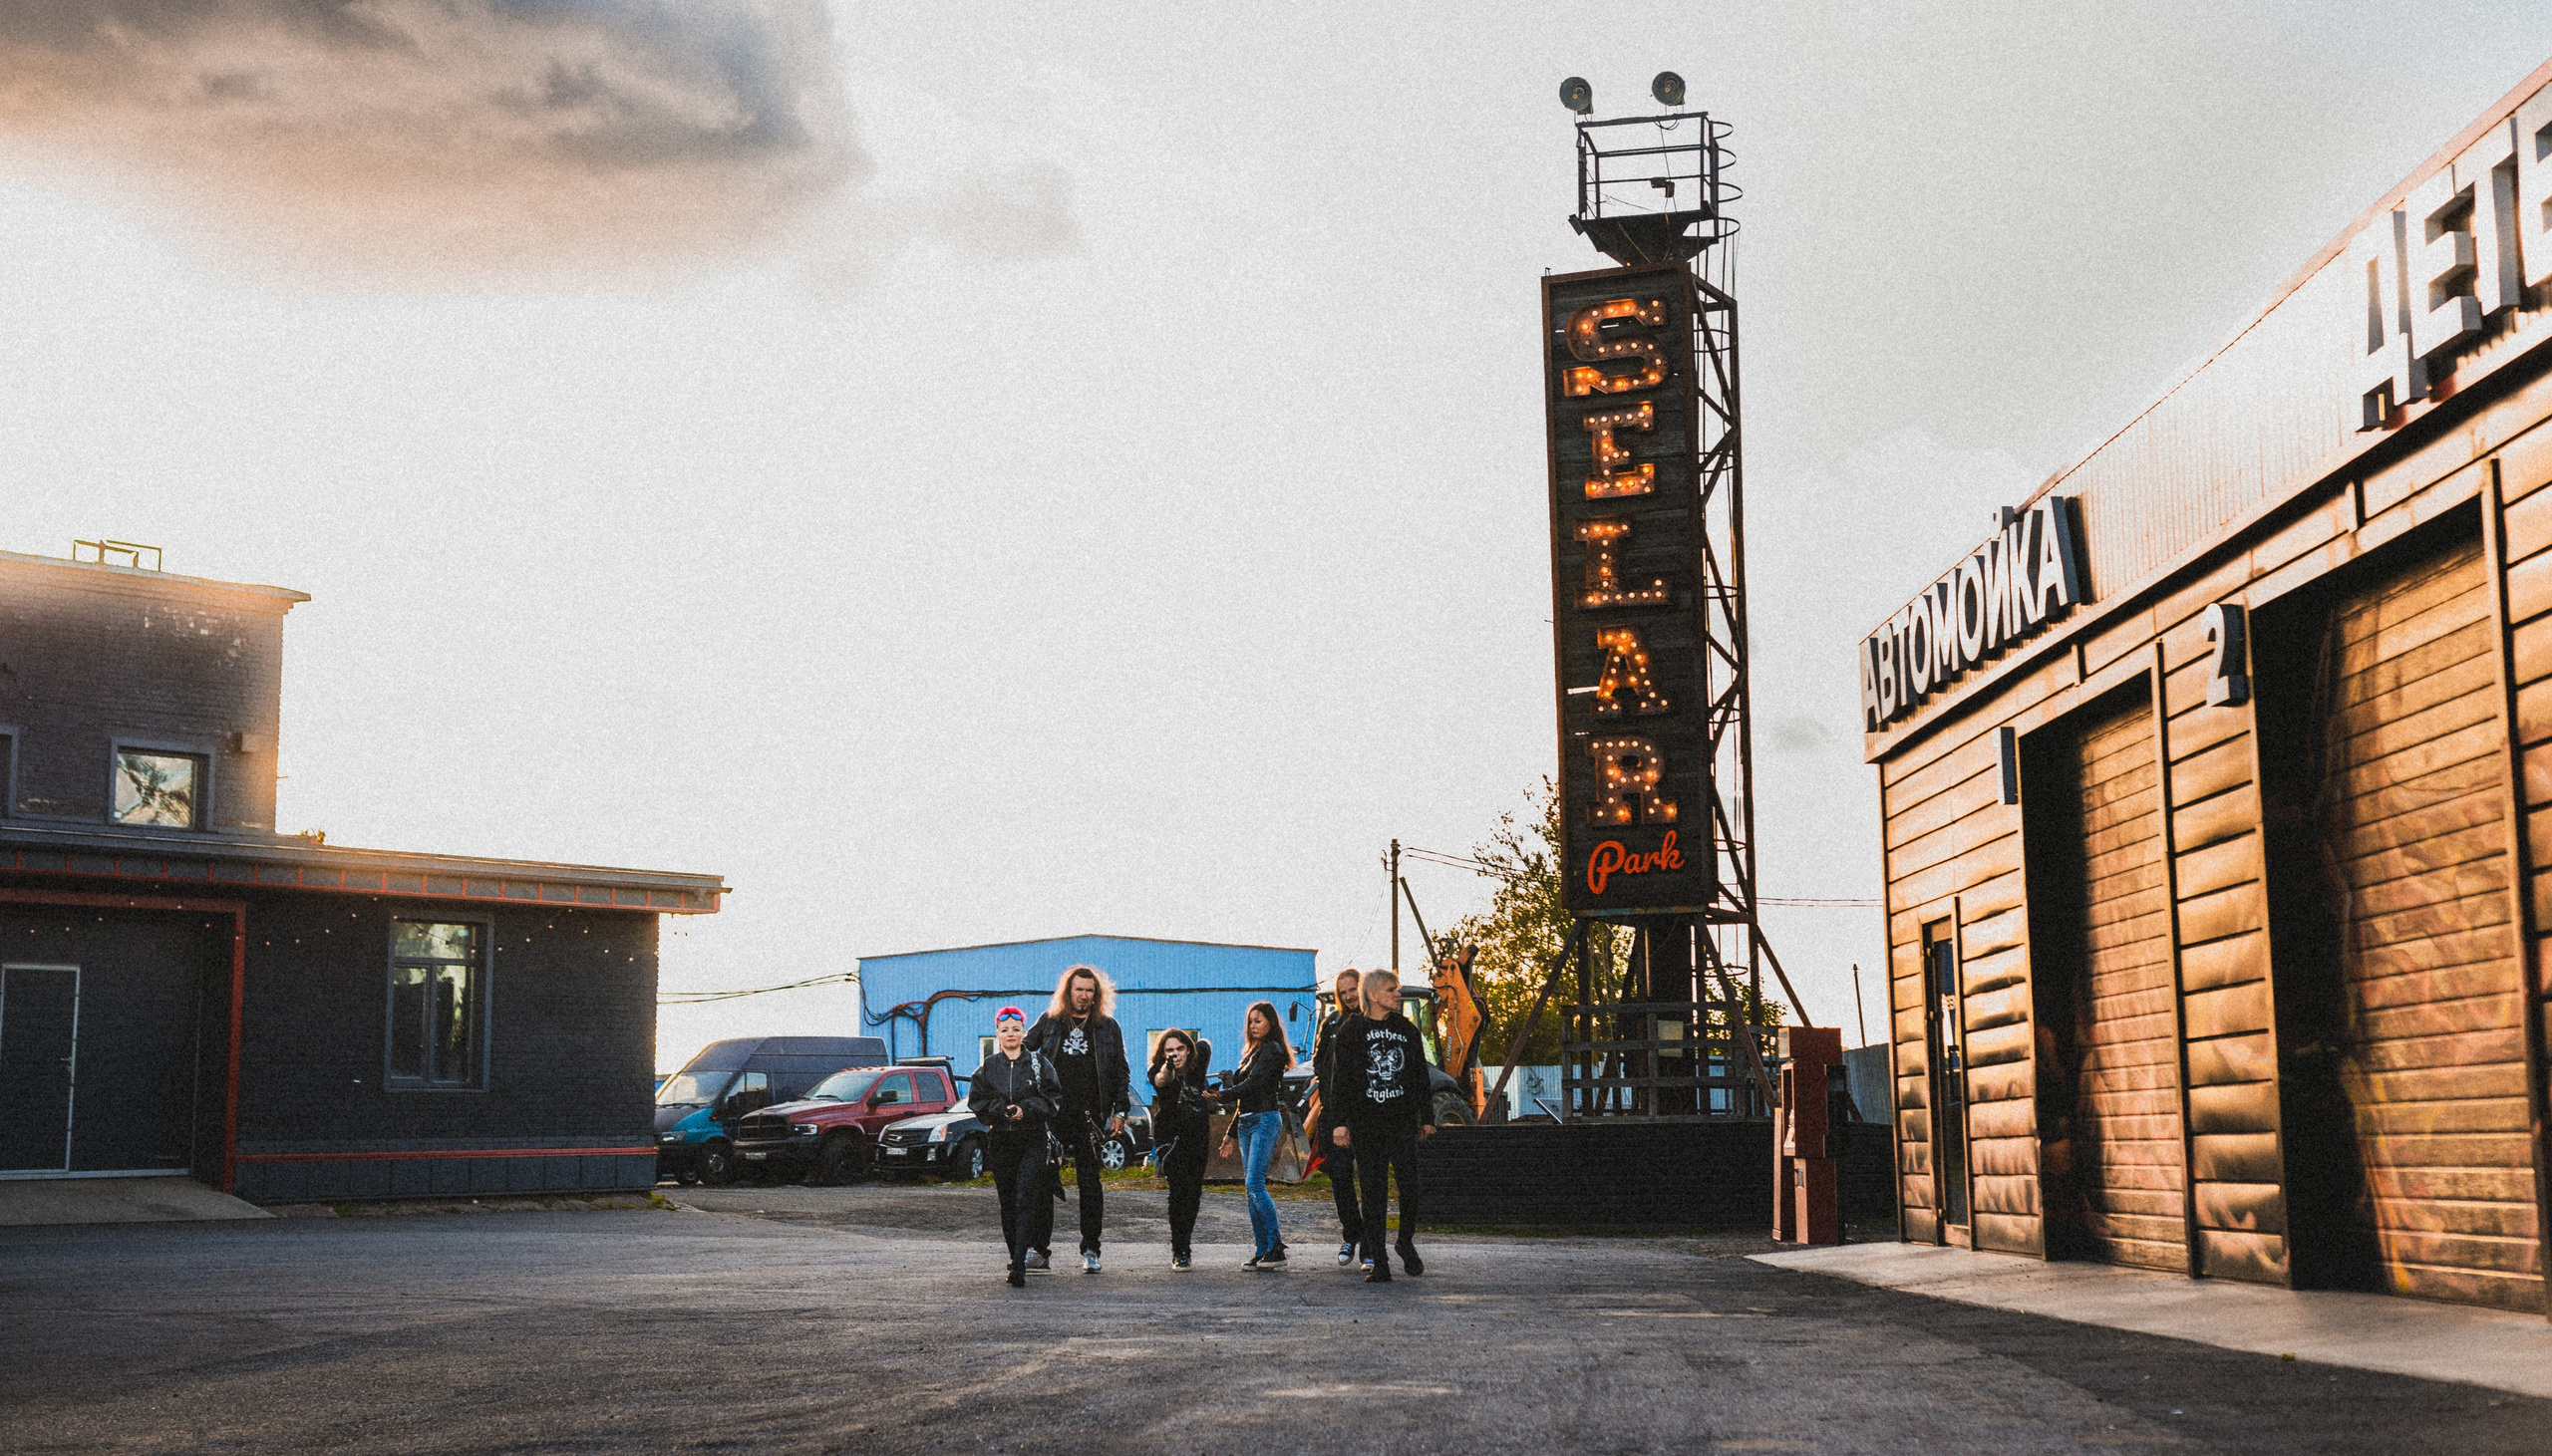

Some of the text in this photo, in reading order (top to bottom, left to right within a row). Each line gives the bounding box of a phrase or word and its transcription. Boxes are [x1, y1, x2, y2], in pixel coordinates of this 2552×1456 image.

[1563, 298, 1678, 827] SELAR
[1862, 495, 2071, 732] АВТОМОЙКА
[2200, 602, 2234, 708] 2
[1587, 830, 1685, 895] Park
[1366, 1085, 1405, 1103] England
